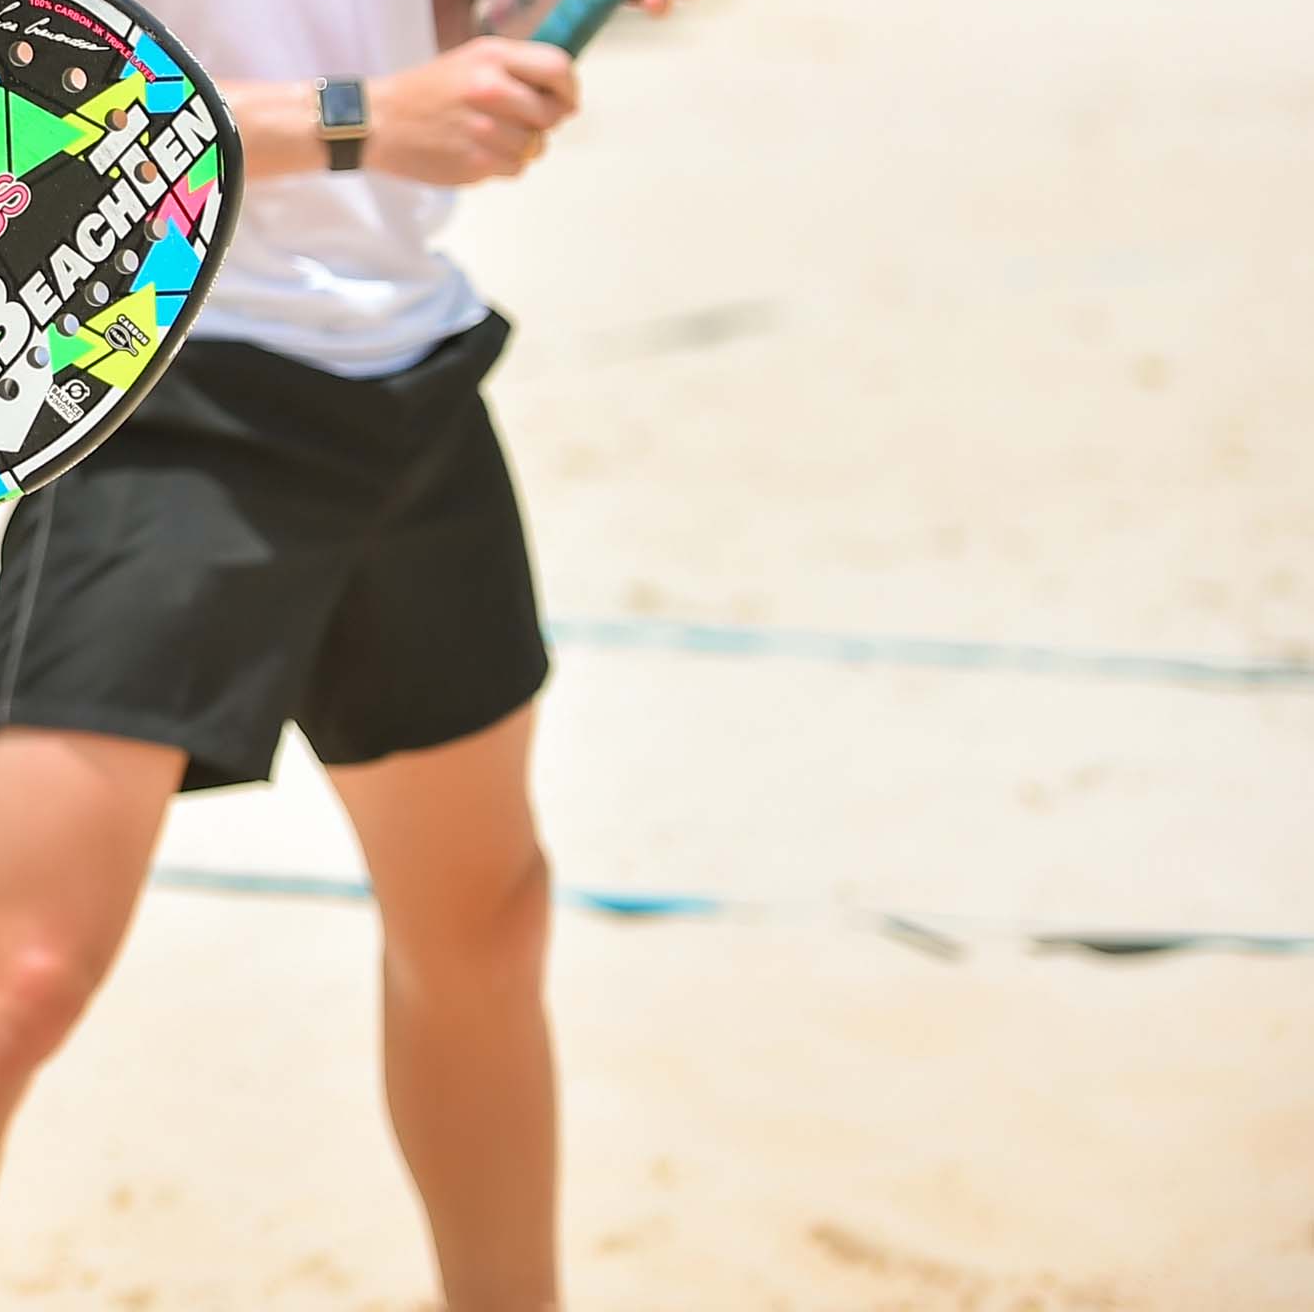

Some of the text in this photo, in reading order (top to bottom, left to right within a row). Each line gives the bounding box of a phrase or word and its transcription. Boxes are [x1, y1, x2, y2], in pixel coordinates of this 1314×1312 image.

[54, 3, 93, 29] CARBON
[91, 23, 104, 37] 3K
[103, 29, 133, 61] TRIPLE
[129, 52, 158, 84] LAYER
[118, 314, 150, 345] CARBON
[51, 386, 83, 417] BALANCE
